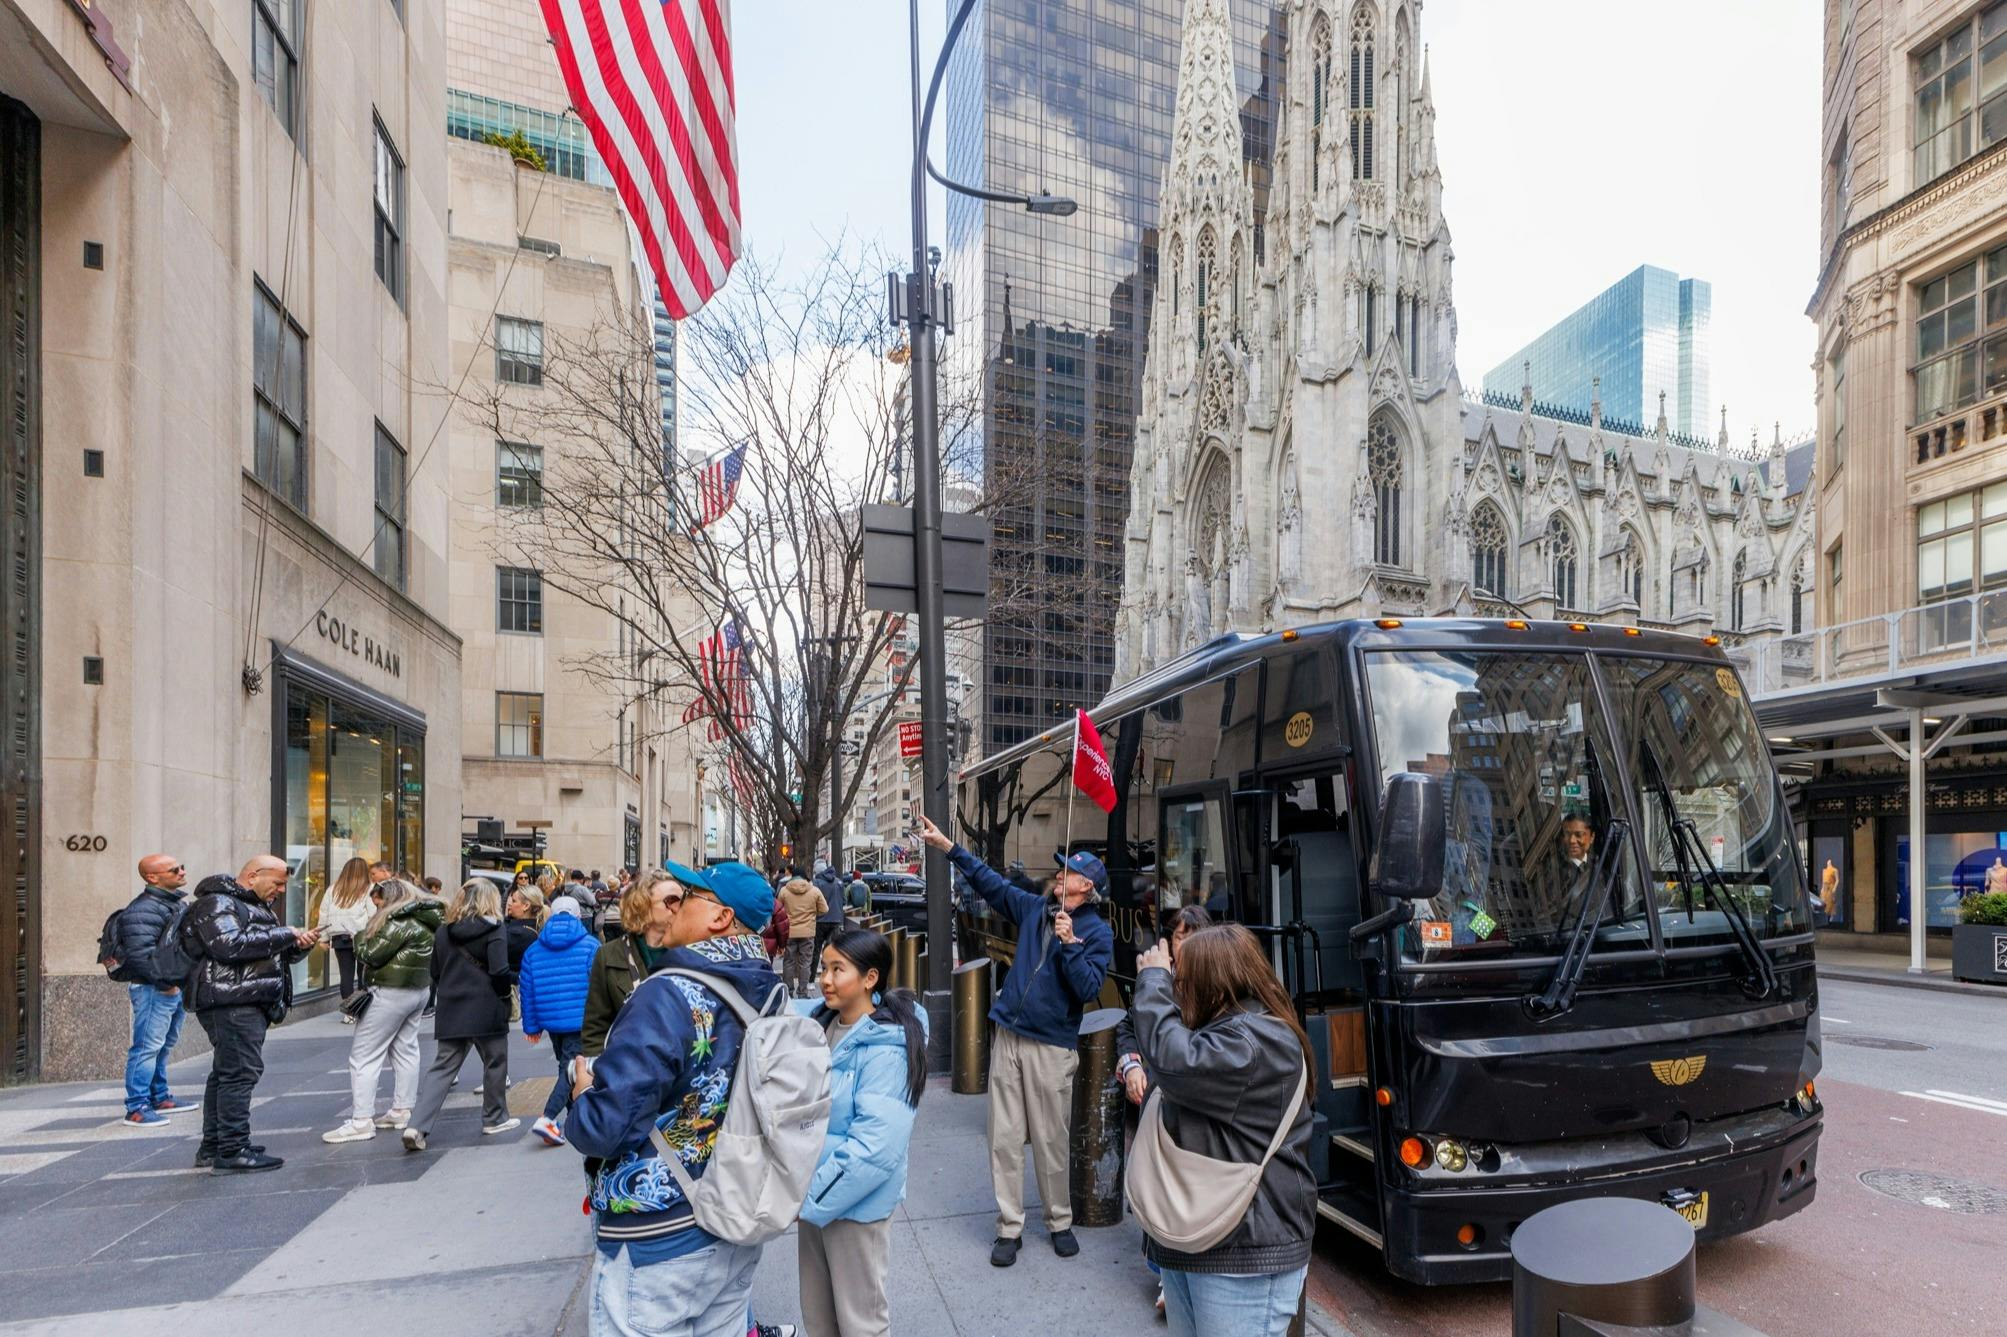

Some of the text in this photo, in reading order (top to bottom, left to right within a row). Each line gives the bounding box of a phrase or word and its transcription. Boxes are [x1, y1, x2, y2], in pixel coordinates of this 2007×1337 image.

[317, 609, 400, 679] COLE HAAN
[900, 723, 923, 734] NO STO
[1288, 717, 1311, 741] 3205
[1093, 764, 1110, 781] NYC
[66, 834, 107, 852] 620
